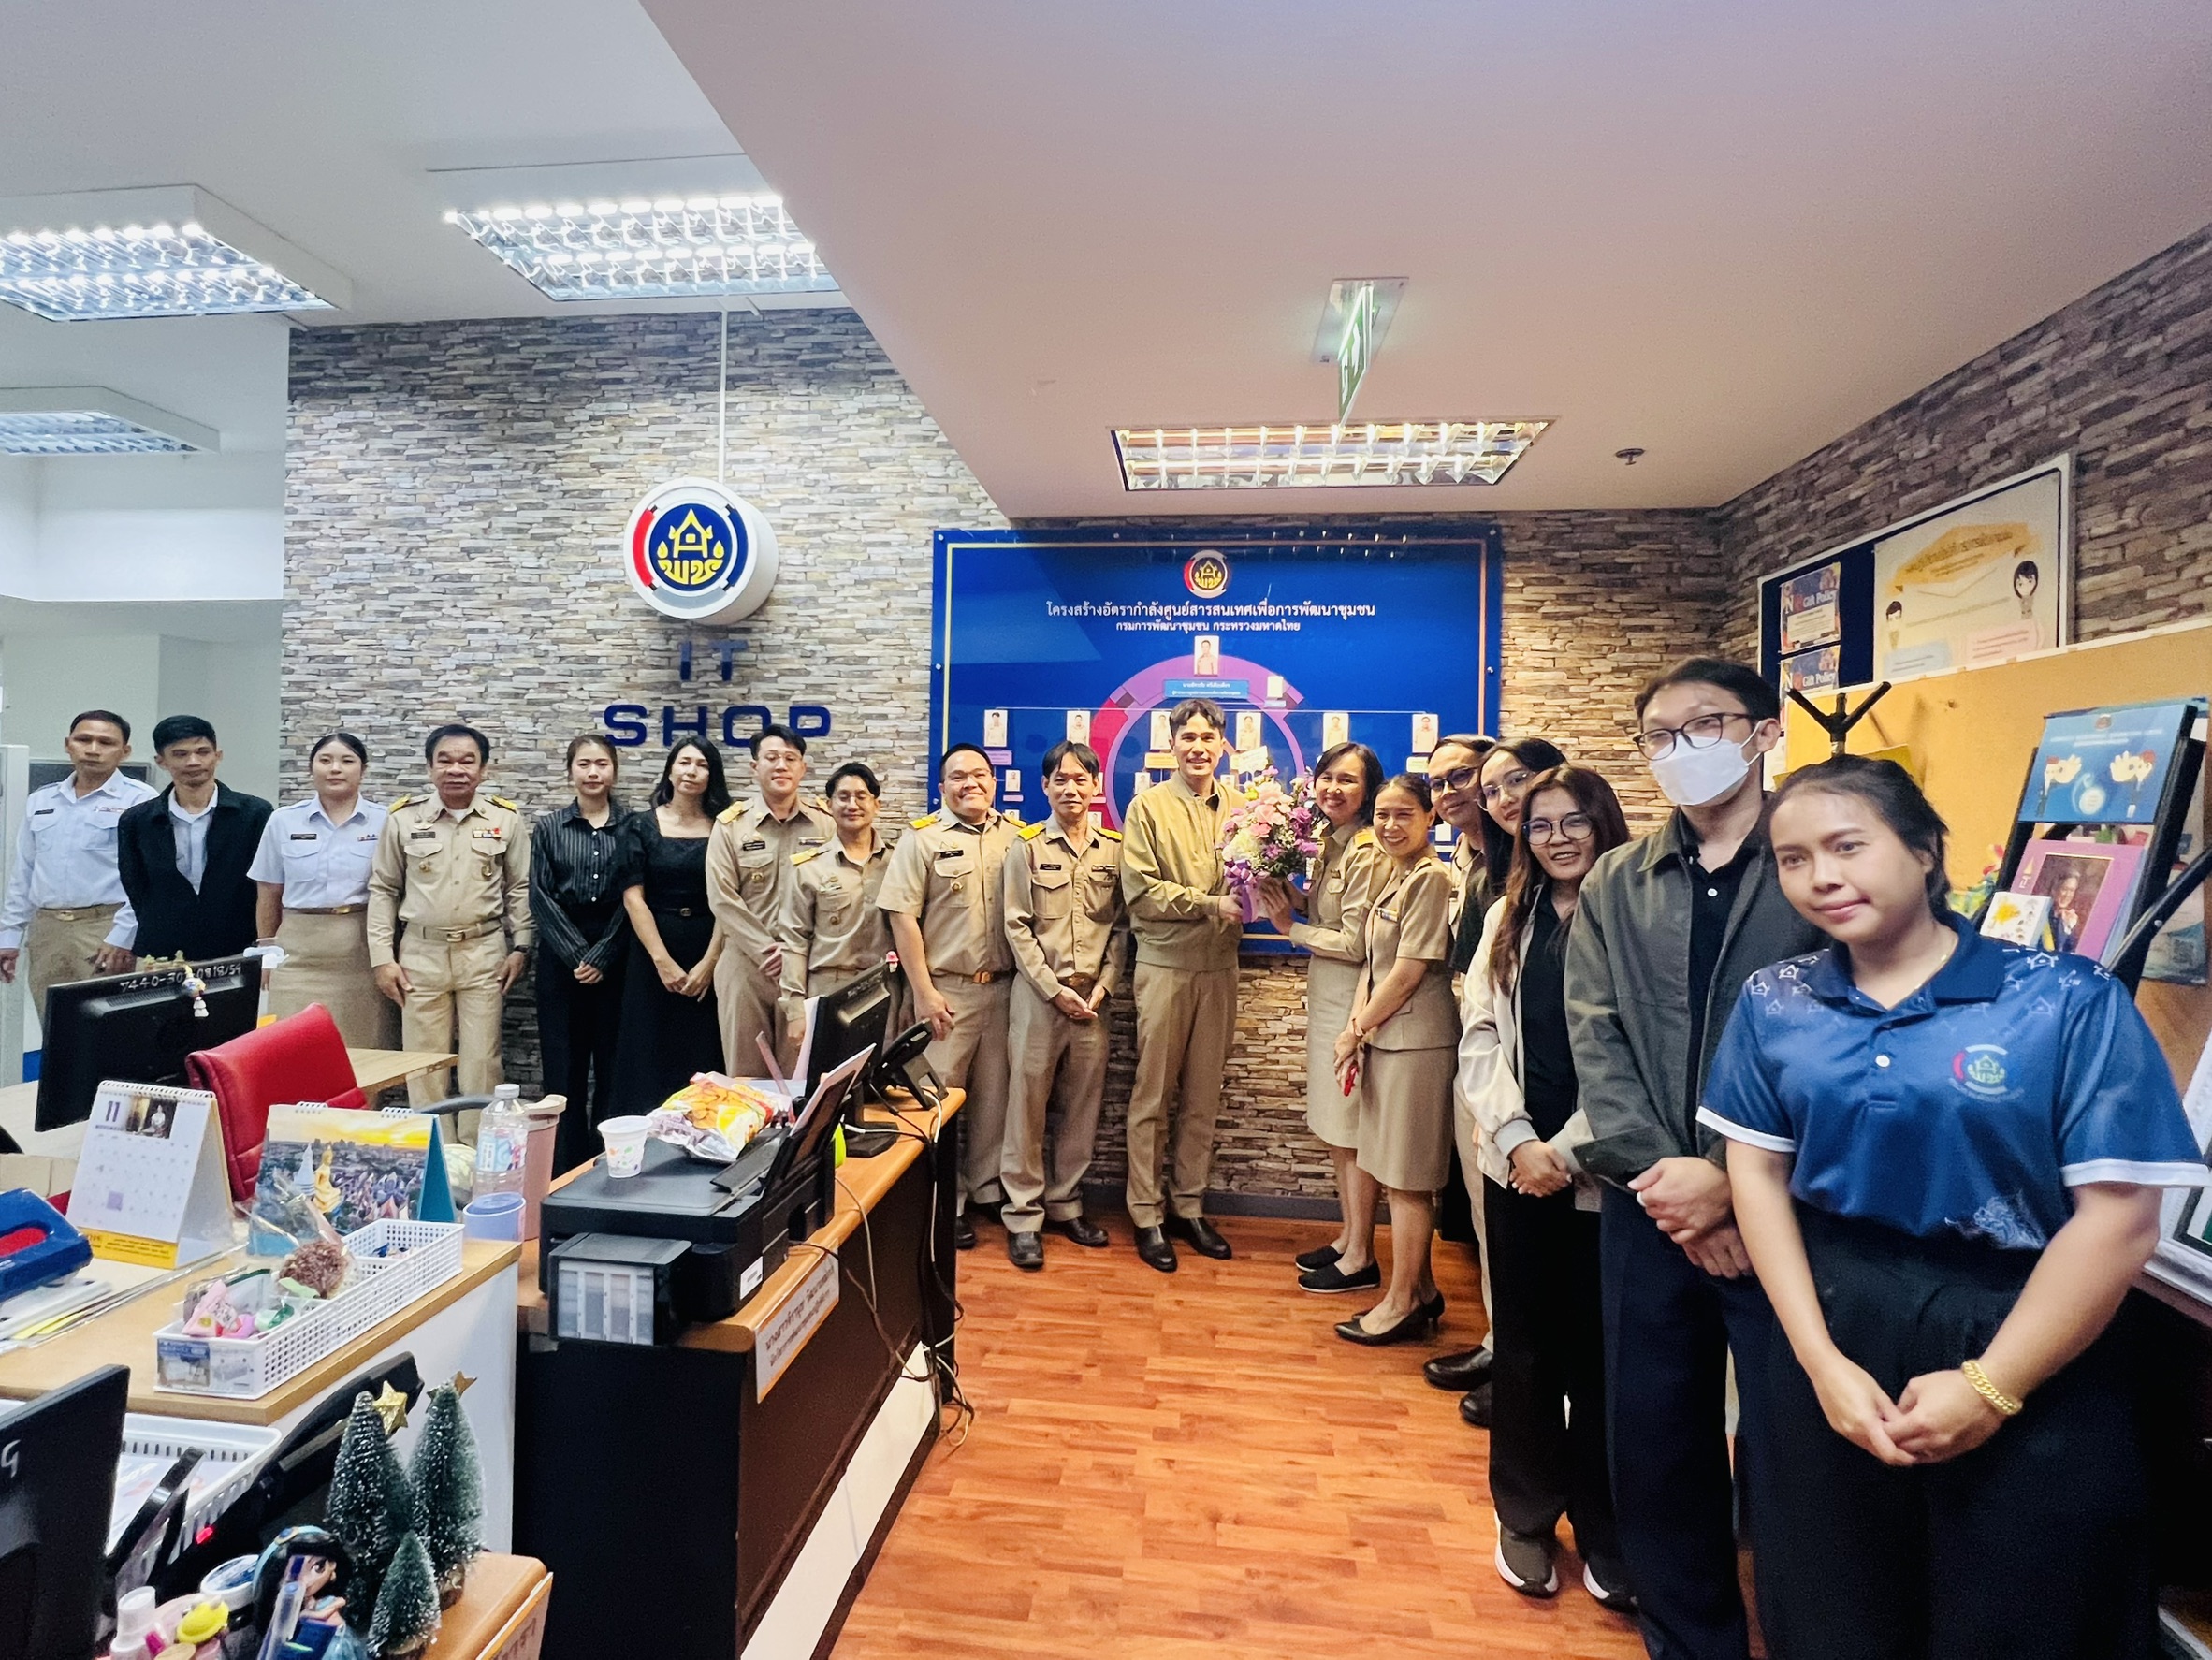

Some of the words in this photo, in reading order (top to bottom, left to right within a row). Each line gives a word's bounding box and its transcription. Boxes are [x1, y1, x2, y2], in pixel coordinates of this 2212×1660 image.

[1046, 598, 1376, 621] โครงสร้างอัตรากำลังศูนย์สารสนเทศเพื่อการพัฒนาชุมชน
[1116, 619, 1210, 634] กรมการพัฒนาชุมชน
[1213, 619, 1301, 632] กระทรวงมหาดไทย
[678, 640, 749, 681] IT
[604, 704, 832, 748] SHOP
[105, 1100, 121, 1123] 11
